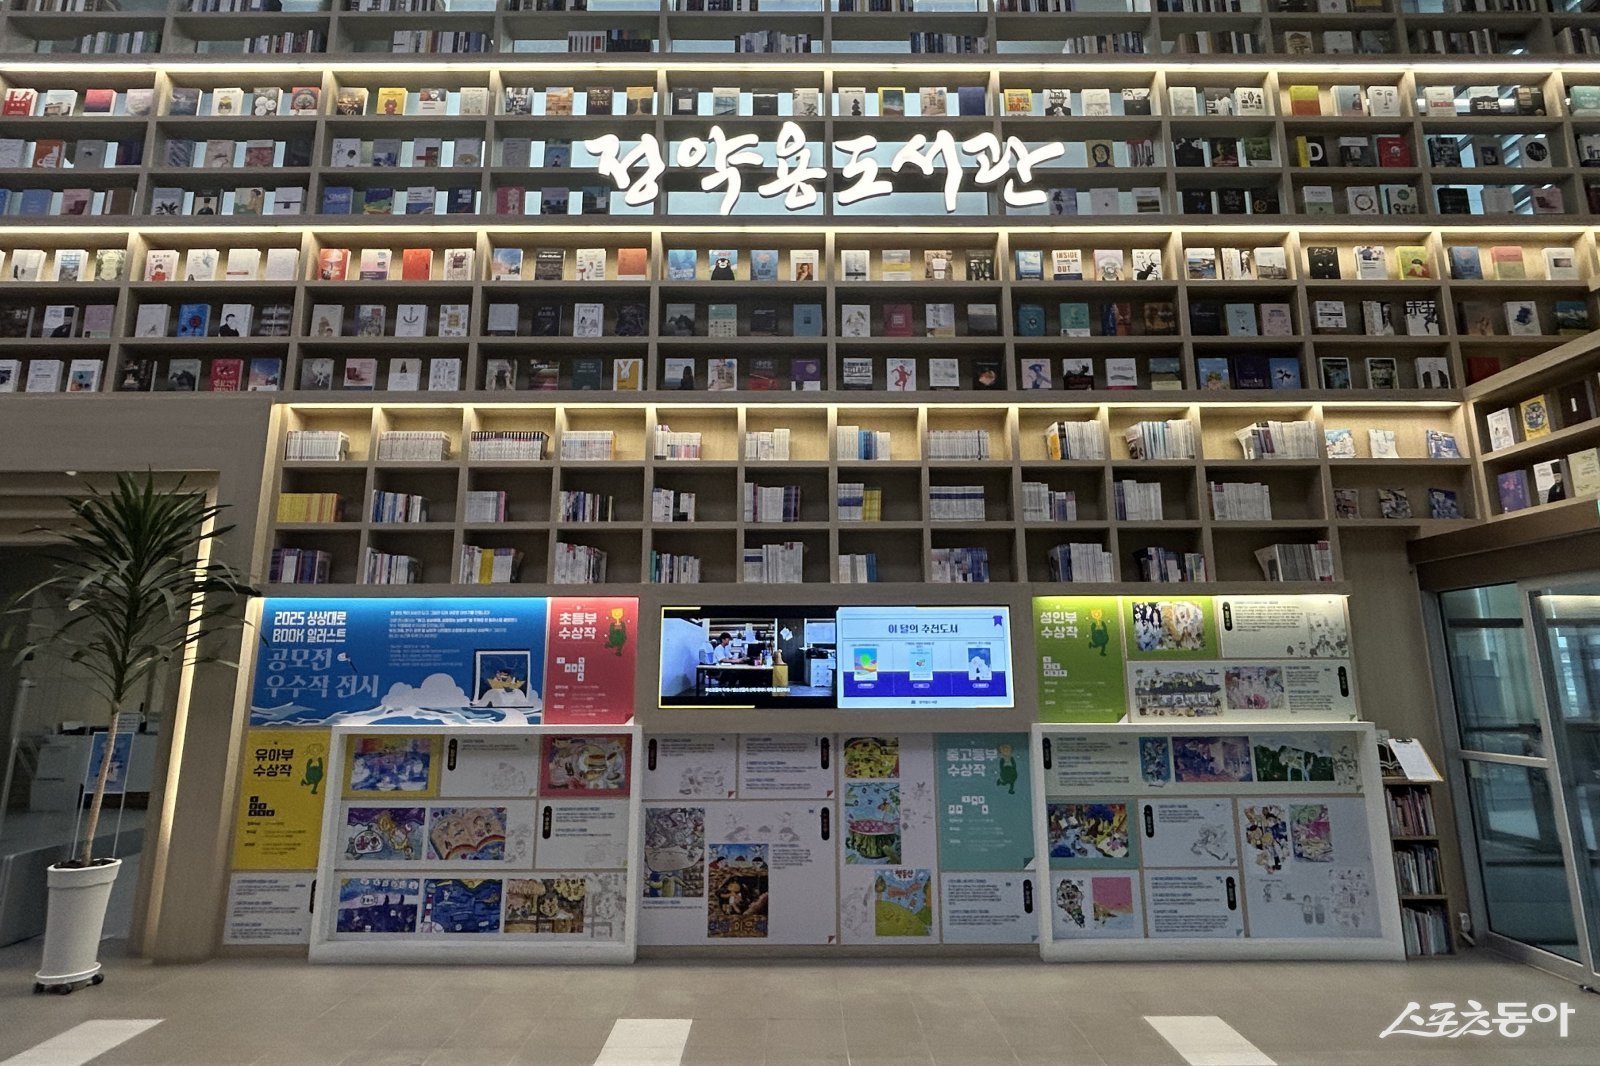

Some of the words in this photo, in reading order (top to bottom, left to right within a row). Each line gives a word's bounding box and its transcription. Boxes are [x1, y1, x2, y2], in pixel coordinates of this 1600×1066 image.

[584, 120, 1066, 217] 정약용도서관
[1056, 251, 1078, 259] INSIDE
[1057, 265, 1071, 273] OUT
[274, 611, 305, 626] 2025
[307, 611, 347, 626] 상상대로
[559, 612, 597, 625] 초등부
[1040, 611, 1077, 625] 성인부
[272, 628, 305, 643] BOOK
[307, 628, 347, 643] 일러스트
[558, 627, 597, 640] 수상작
[888, 624, 897, 633] 이
[900, 624, 919, 633] 달의
[921, 624, 959, 634] 추천도서
[1041, 626, 1078, 639] 수상작
[267, 648, 333, 671] 공모전
[263, 675, 330, 698] 우수작
[335, 675, 379, 698] 전시
[255, 748, 294, 762] 유아부
[946, 748, 998, 761] 중고등부
[253, 764, 293, 777] 수상작
[947, 763, 987, 777] 수상작
